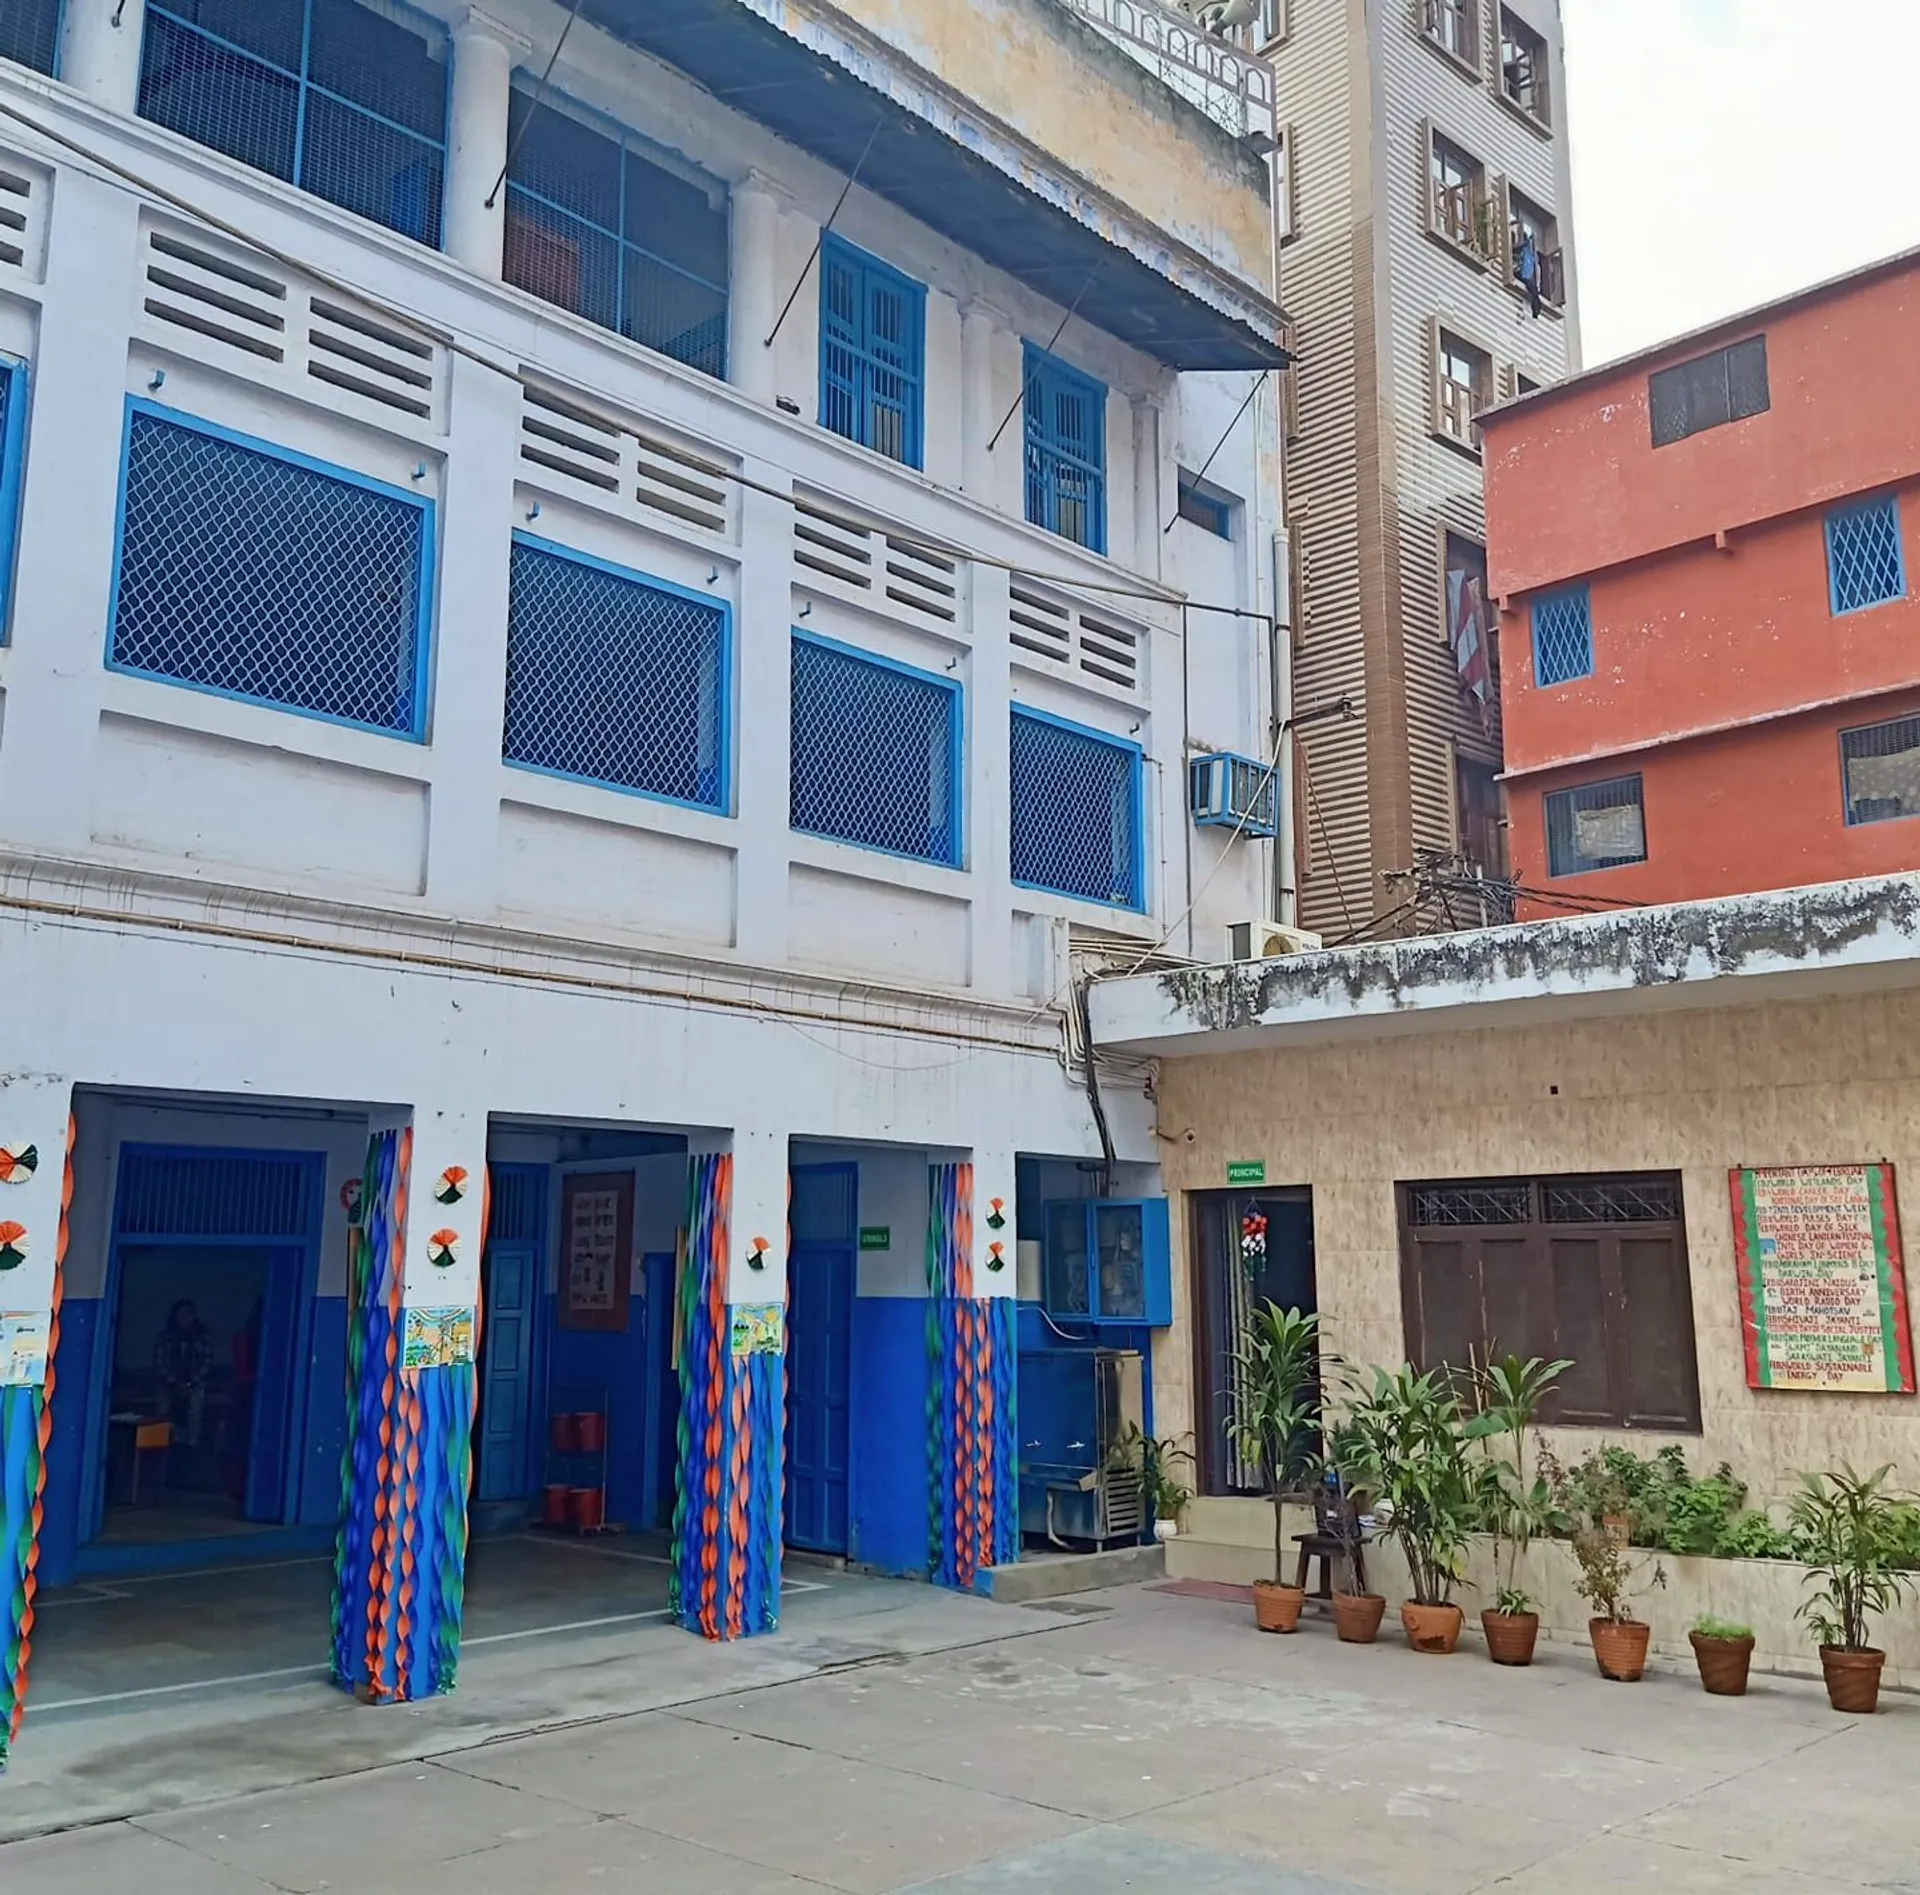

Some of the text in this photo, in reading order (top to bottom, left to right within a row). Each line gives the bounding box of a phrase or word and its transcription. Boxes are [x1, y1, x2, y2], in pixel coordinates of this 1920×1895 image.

[1229, 1168, 1264, 1178] PRINCIPAL
[1846, 1175, 1863, 1185] DAY
[1835, 1213, 1851, 1222] DAY
[1805, 1223, 1822, 1232] DAY
[1798, 1241, 1813, 1251] DAY
[1844, 1296, 1861, 1305] DAY
[1787, 1371, 1844, 1382] ENERGY DAY
